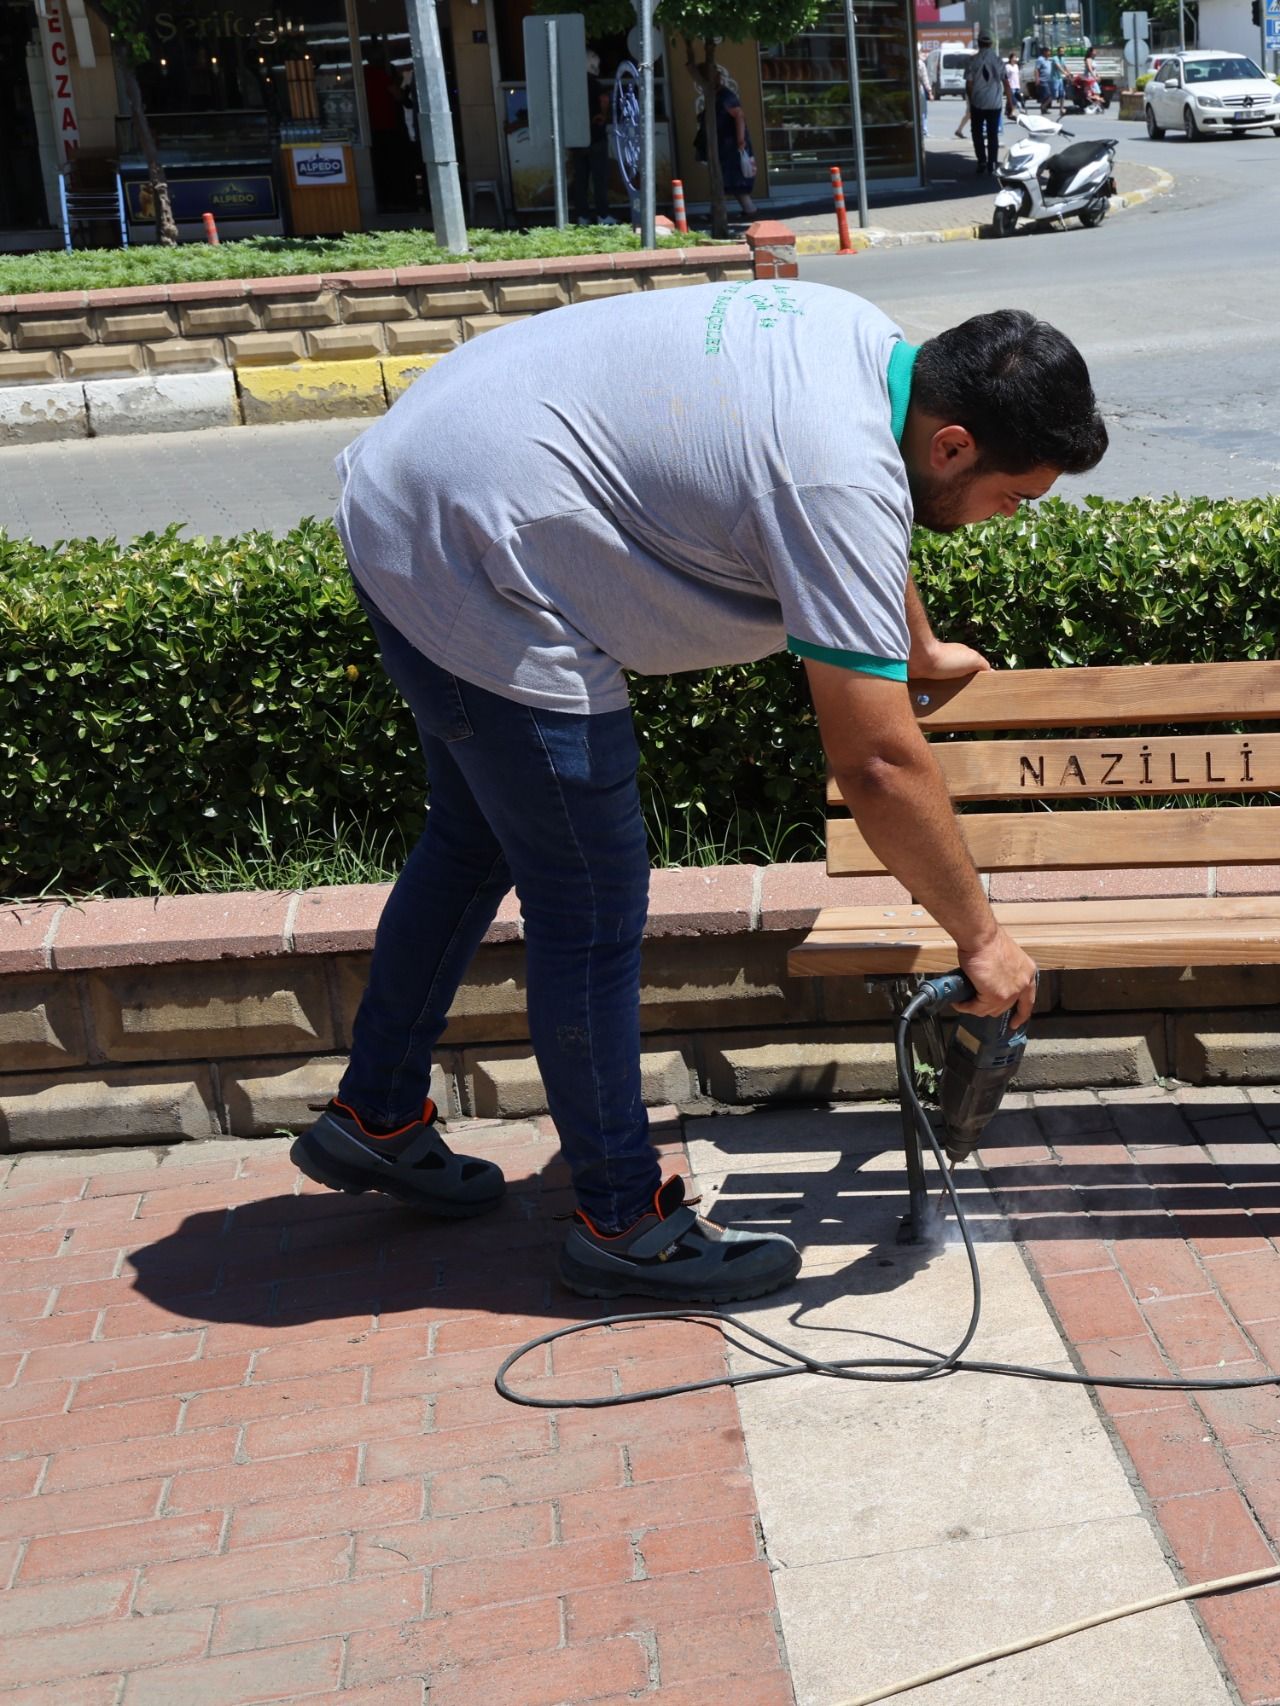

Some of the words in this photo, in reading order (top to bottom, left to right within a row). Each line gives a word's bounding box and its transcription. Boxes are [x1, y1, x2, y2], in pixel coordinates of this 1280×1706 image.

[47, 9, 79, 172] ECZAN
[299, 161, 341, 173] ALPEDO
[212, 194, 255, 204] ALPEDO
[1020, 742, 1254, 786] NAZİLLİ
